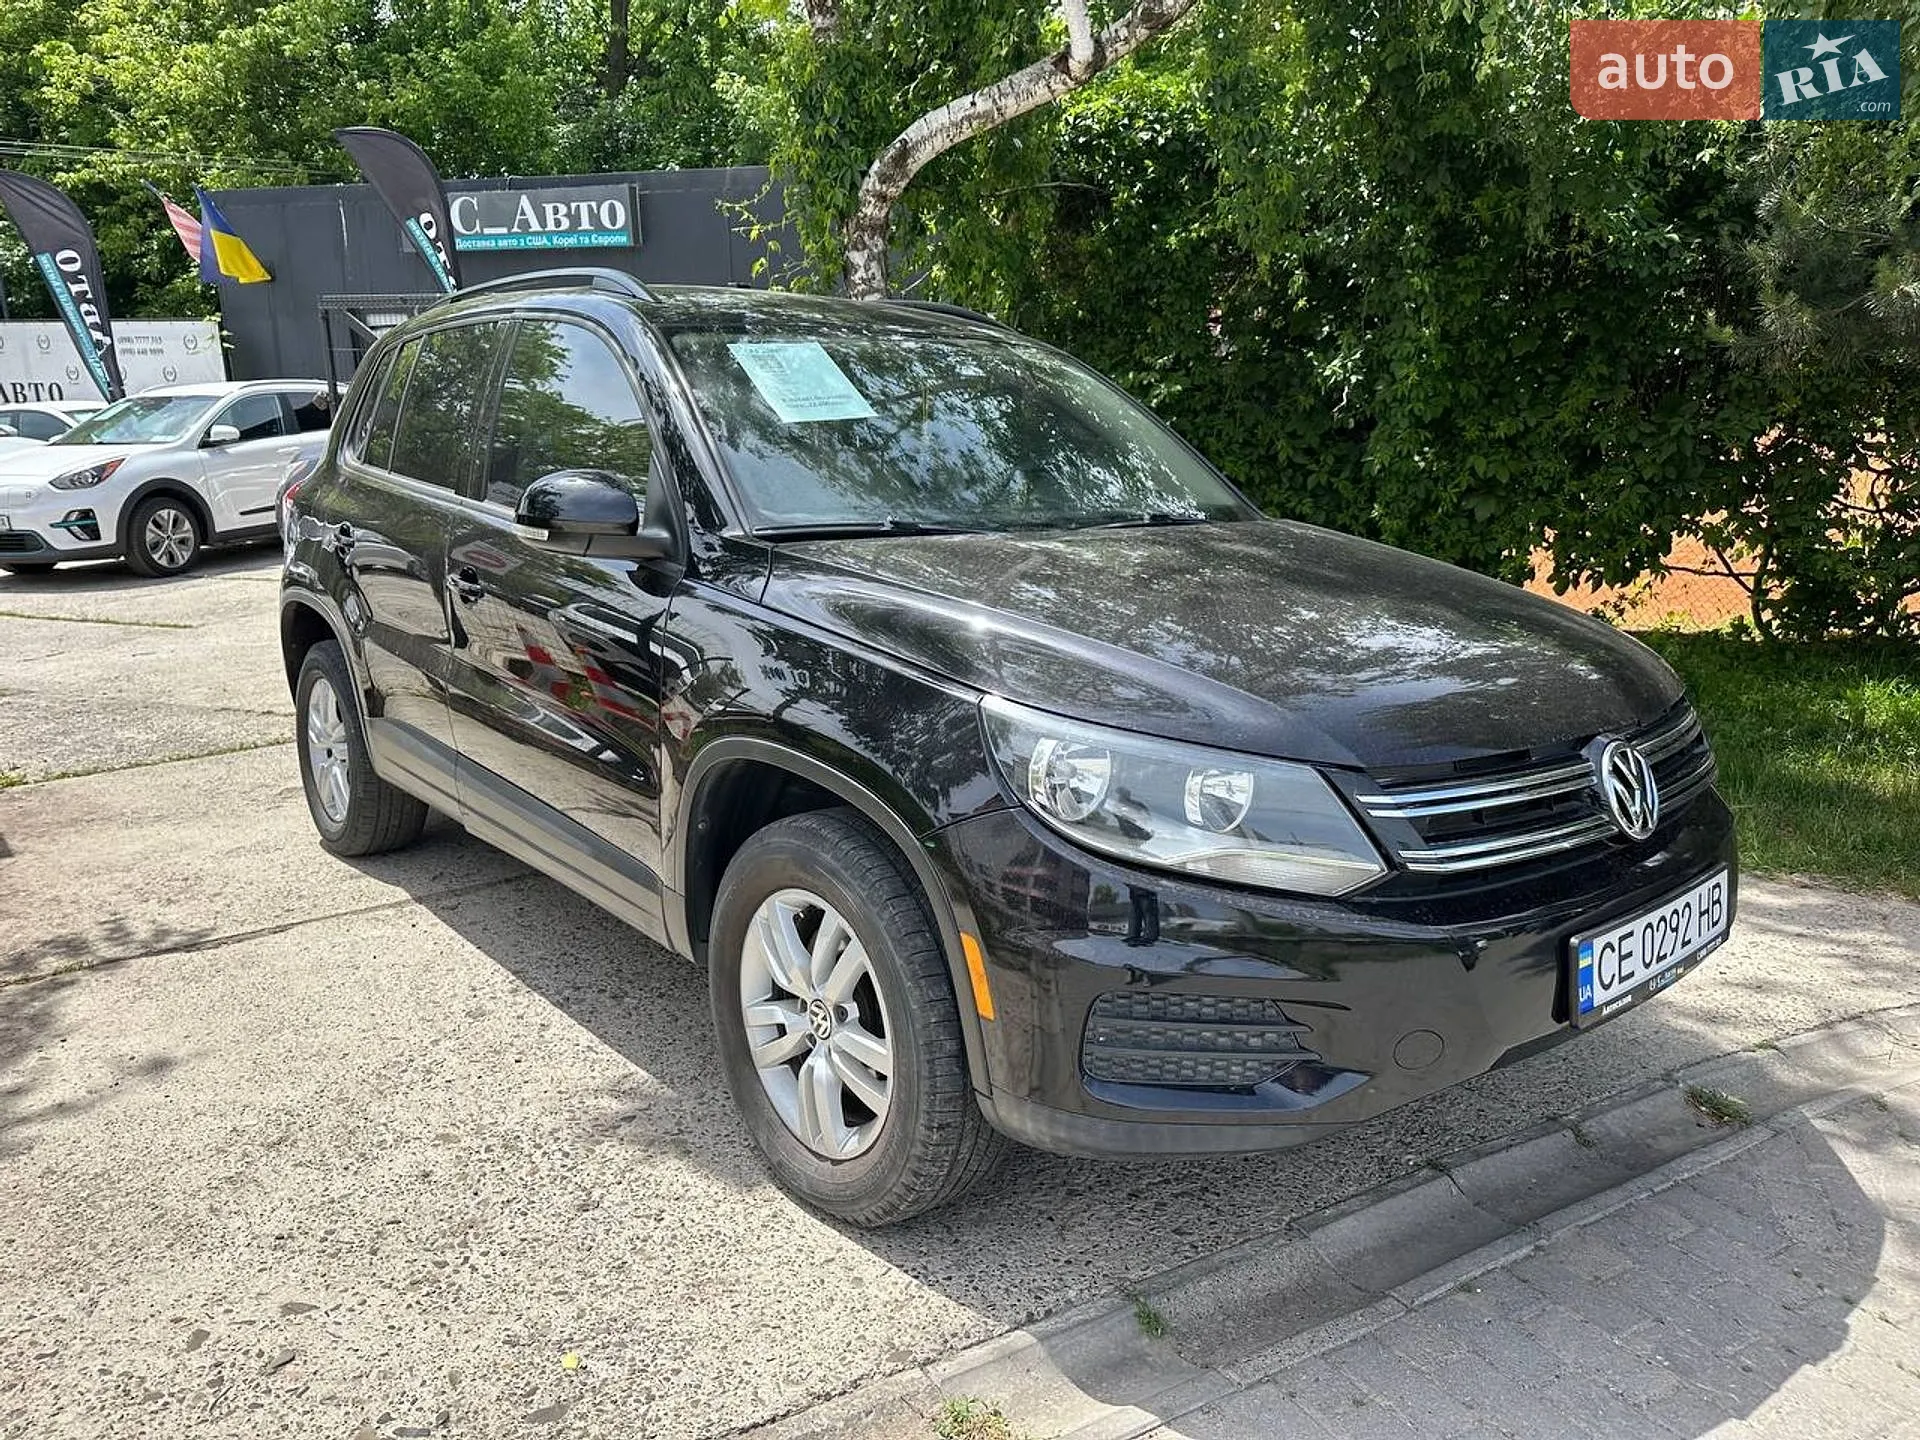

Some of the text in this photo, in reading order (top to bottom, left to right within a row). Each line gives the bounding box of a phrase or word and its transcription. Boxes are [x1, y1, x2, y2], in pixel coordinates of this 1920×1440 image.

[1597, 881, 1722, 992] CE 0292 HB
[1579, 987, 1592, 1002] UA
